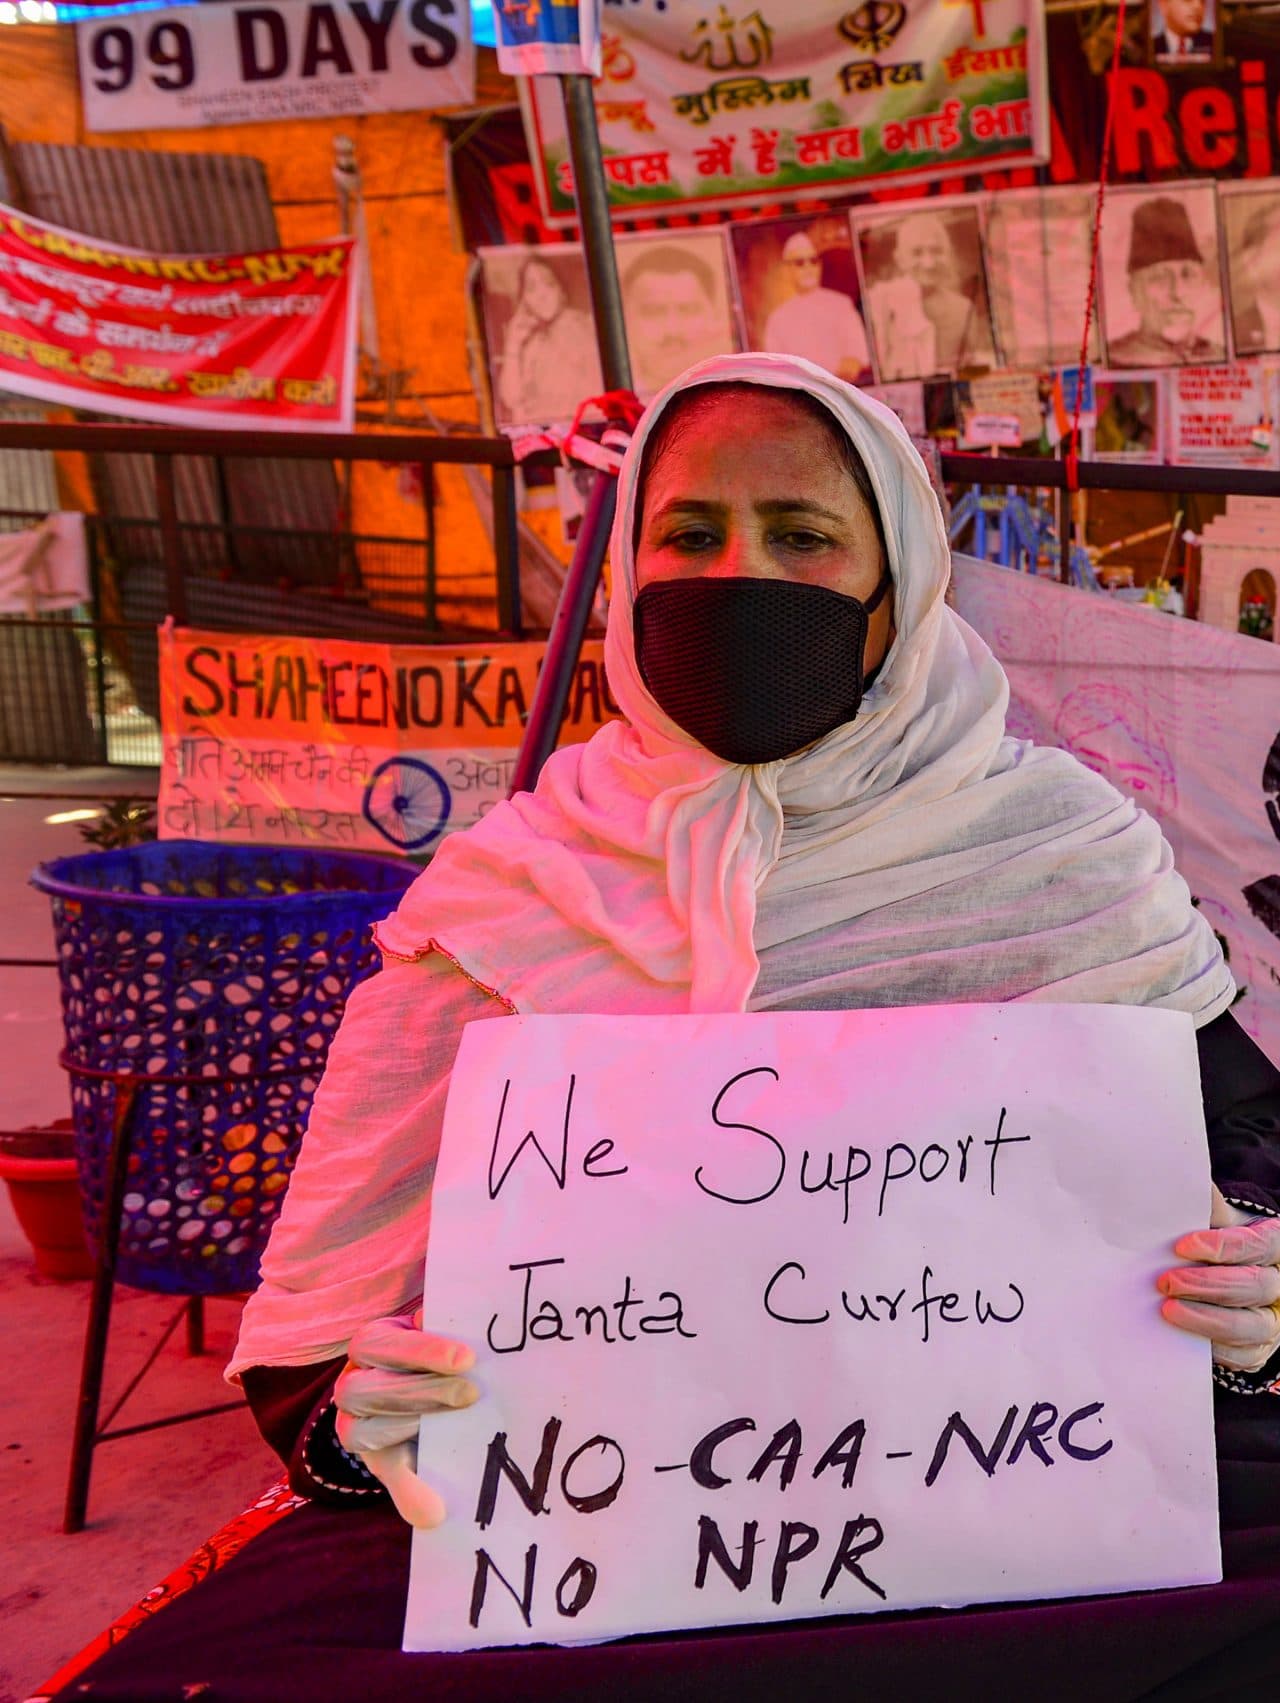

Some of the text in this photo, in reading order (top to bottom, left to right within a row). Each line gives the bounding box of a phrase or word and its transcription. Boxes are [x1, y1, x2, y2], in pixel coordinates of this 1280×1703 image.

[91, 0, 459, 93] 99 DAYS
[972, 98, 1034, 140] भा
[487, 1066, 1031, 1224] We Support
[486, 1256, 1026, 1355] Janta Curfew
[693, 1512, 888, 1606] NPR
